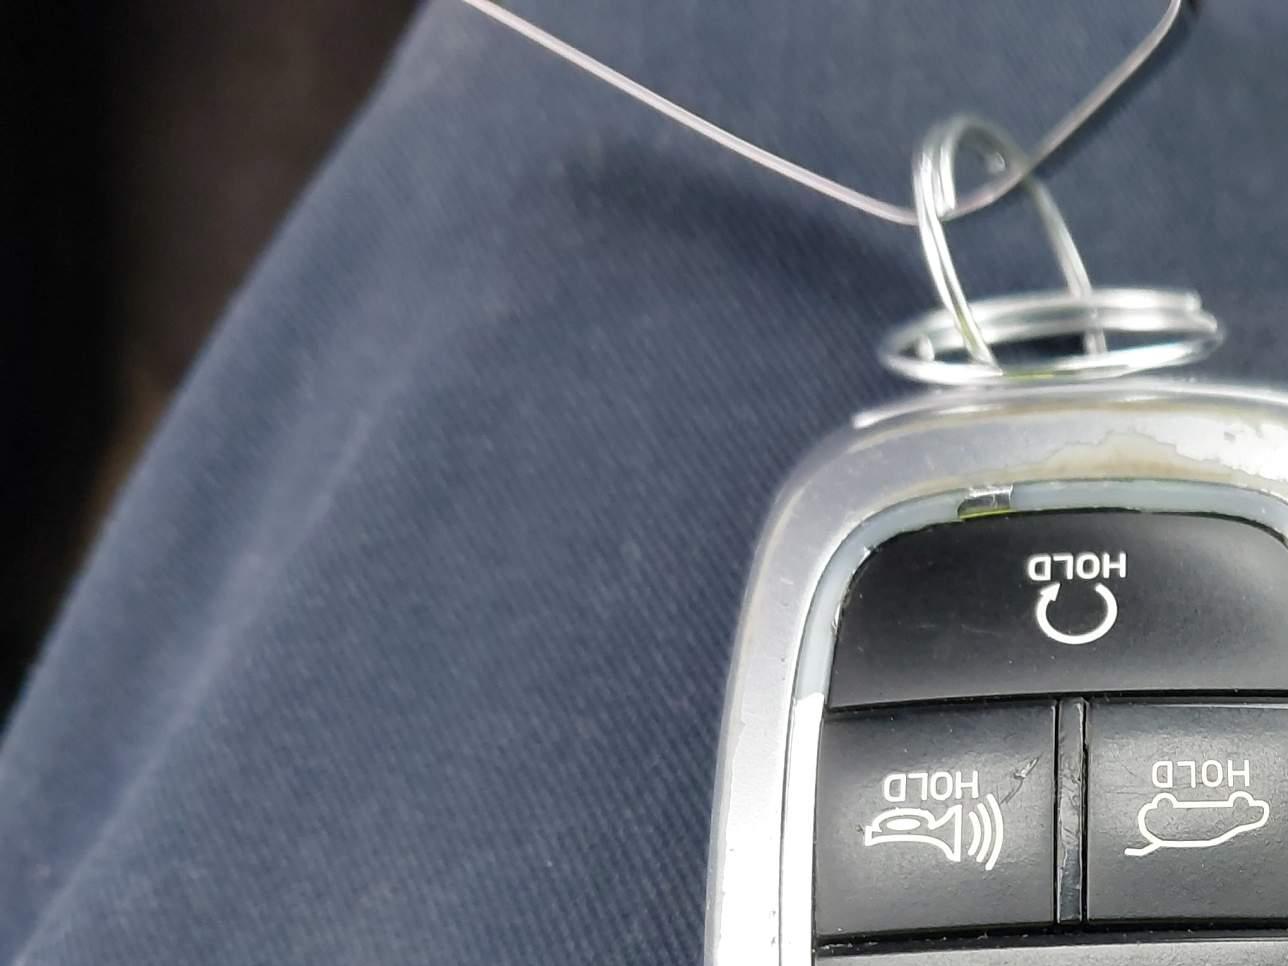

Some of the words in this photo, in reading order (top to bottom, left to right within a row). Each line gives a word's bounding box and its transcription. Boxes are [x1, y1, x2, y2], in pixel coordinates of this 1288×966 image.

[1026, 551, 1127, 582] HOLD
[884, 771, 979, 801] HOLD
[1152, 759, 1251, 787] HOLD
